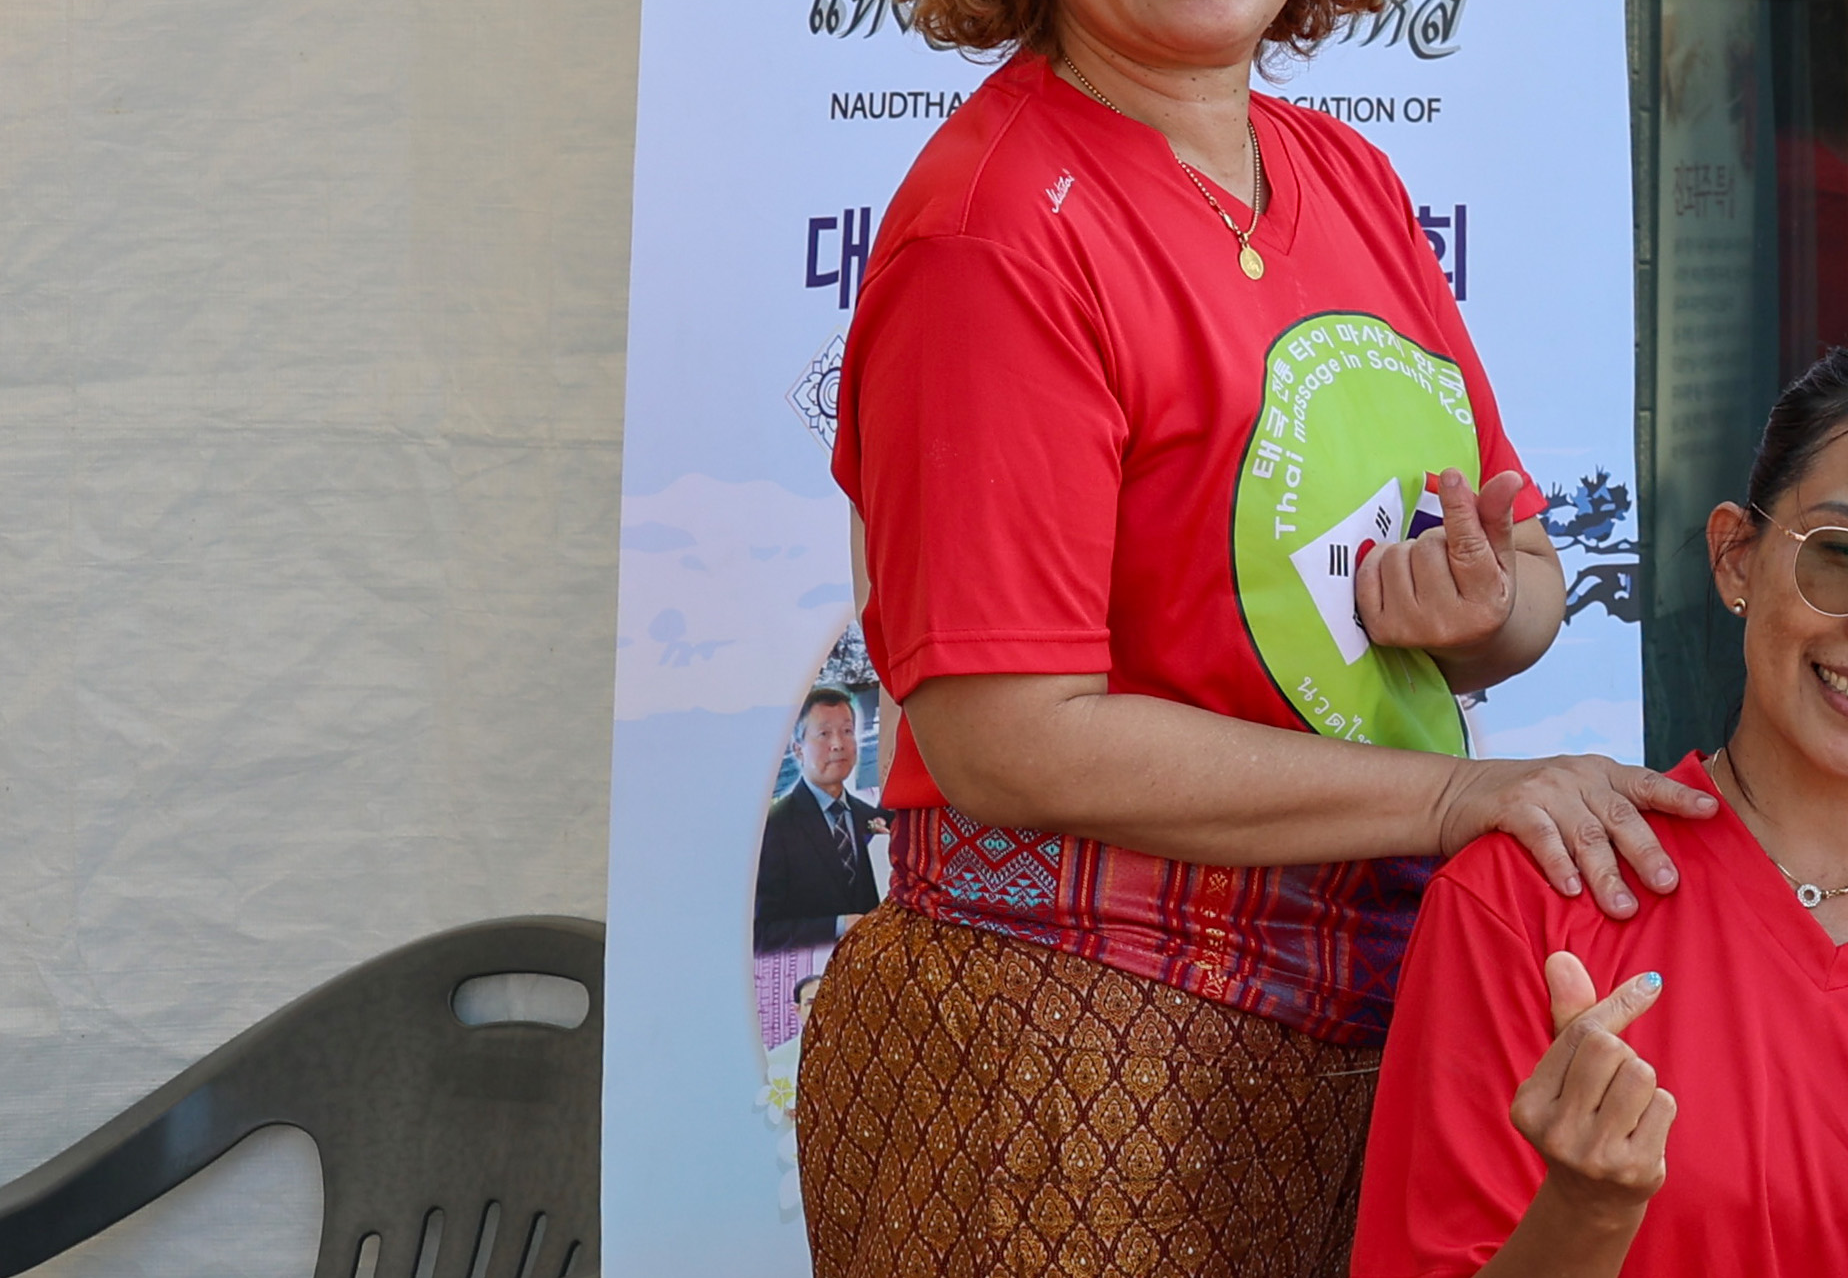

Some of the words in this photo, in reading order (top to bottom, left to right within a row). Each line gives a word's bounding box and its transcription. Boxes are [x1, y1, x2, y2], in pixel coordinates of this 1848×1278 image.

[830, 92, 968, 120] NAUDTHA
[1404, 97, 1442, 122] OF
[805, 206, 872, 310] 대
[1252, 406, 1290, 480] 태국
[1287, 329, 1334, 363] 타이
[1275, 450, 1306, 540] Thai
[1292, 358, 1341, 443] massage
[1341, 349, 1361, 370] in
[1370, 349, 1434, 393] South
